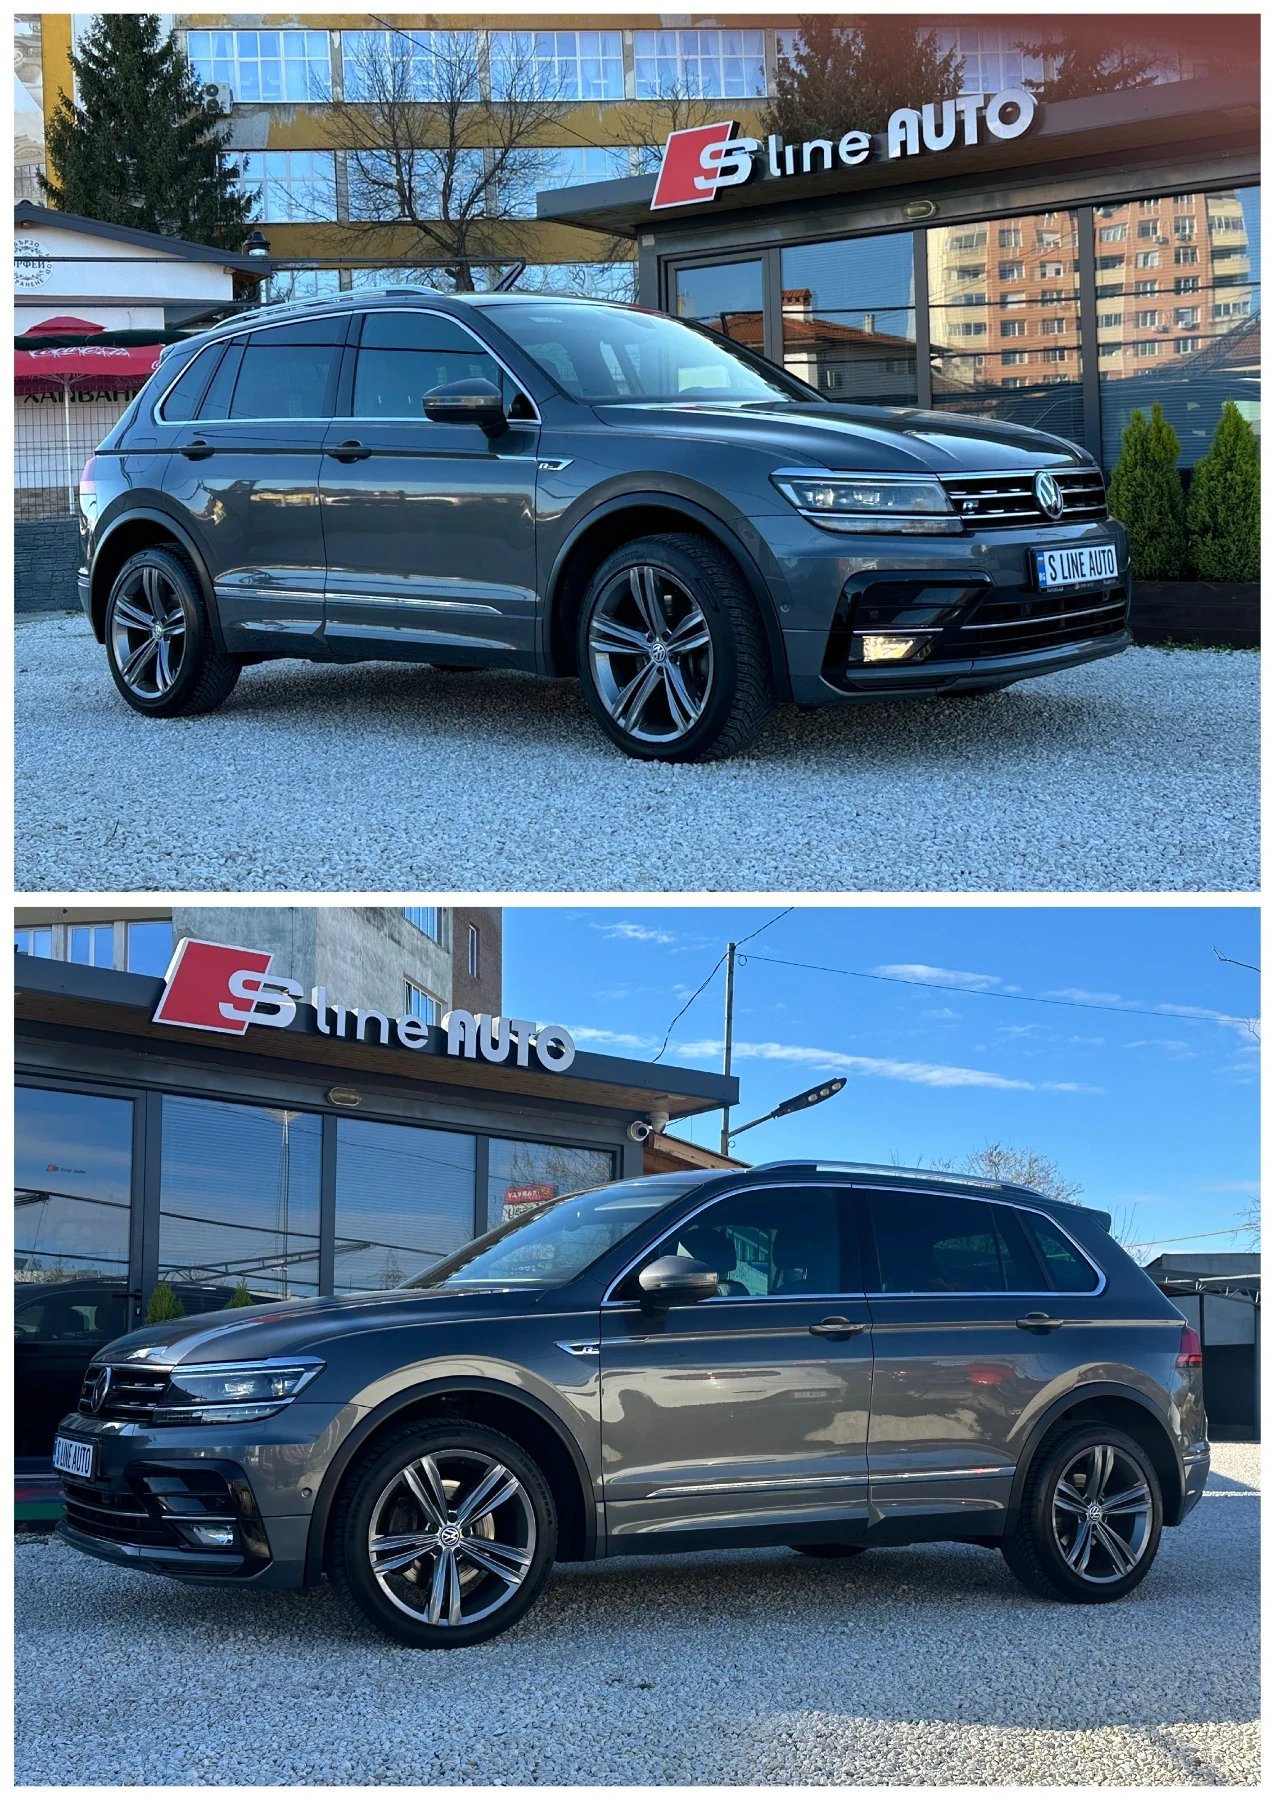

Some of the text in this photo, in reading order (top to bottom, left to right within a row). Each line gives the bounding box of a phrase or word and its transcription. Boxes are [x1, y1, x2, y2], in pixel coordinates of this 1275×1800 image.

[694, 88, 1037, 190] S line AUTO
[14, 257, 45, 269] РФЕЙ
[23, 389, 137, 404] ХАПВАН
[1048, 548, 1115, 582] S LINE AUTO
[219, 969, 577, 1073] S line AUTO
[72, 1444, 91, 1474] AUTO
